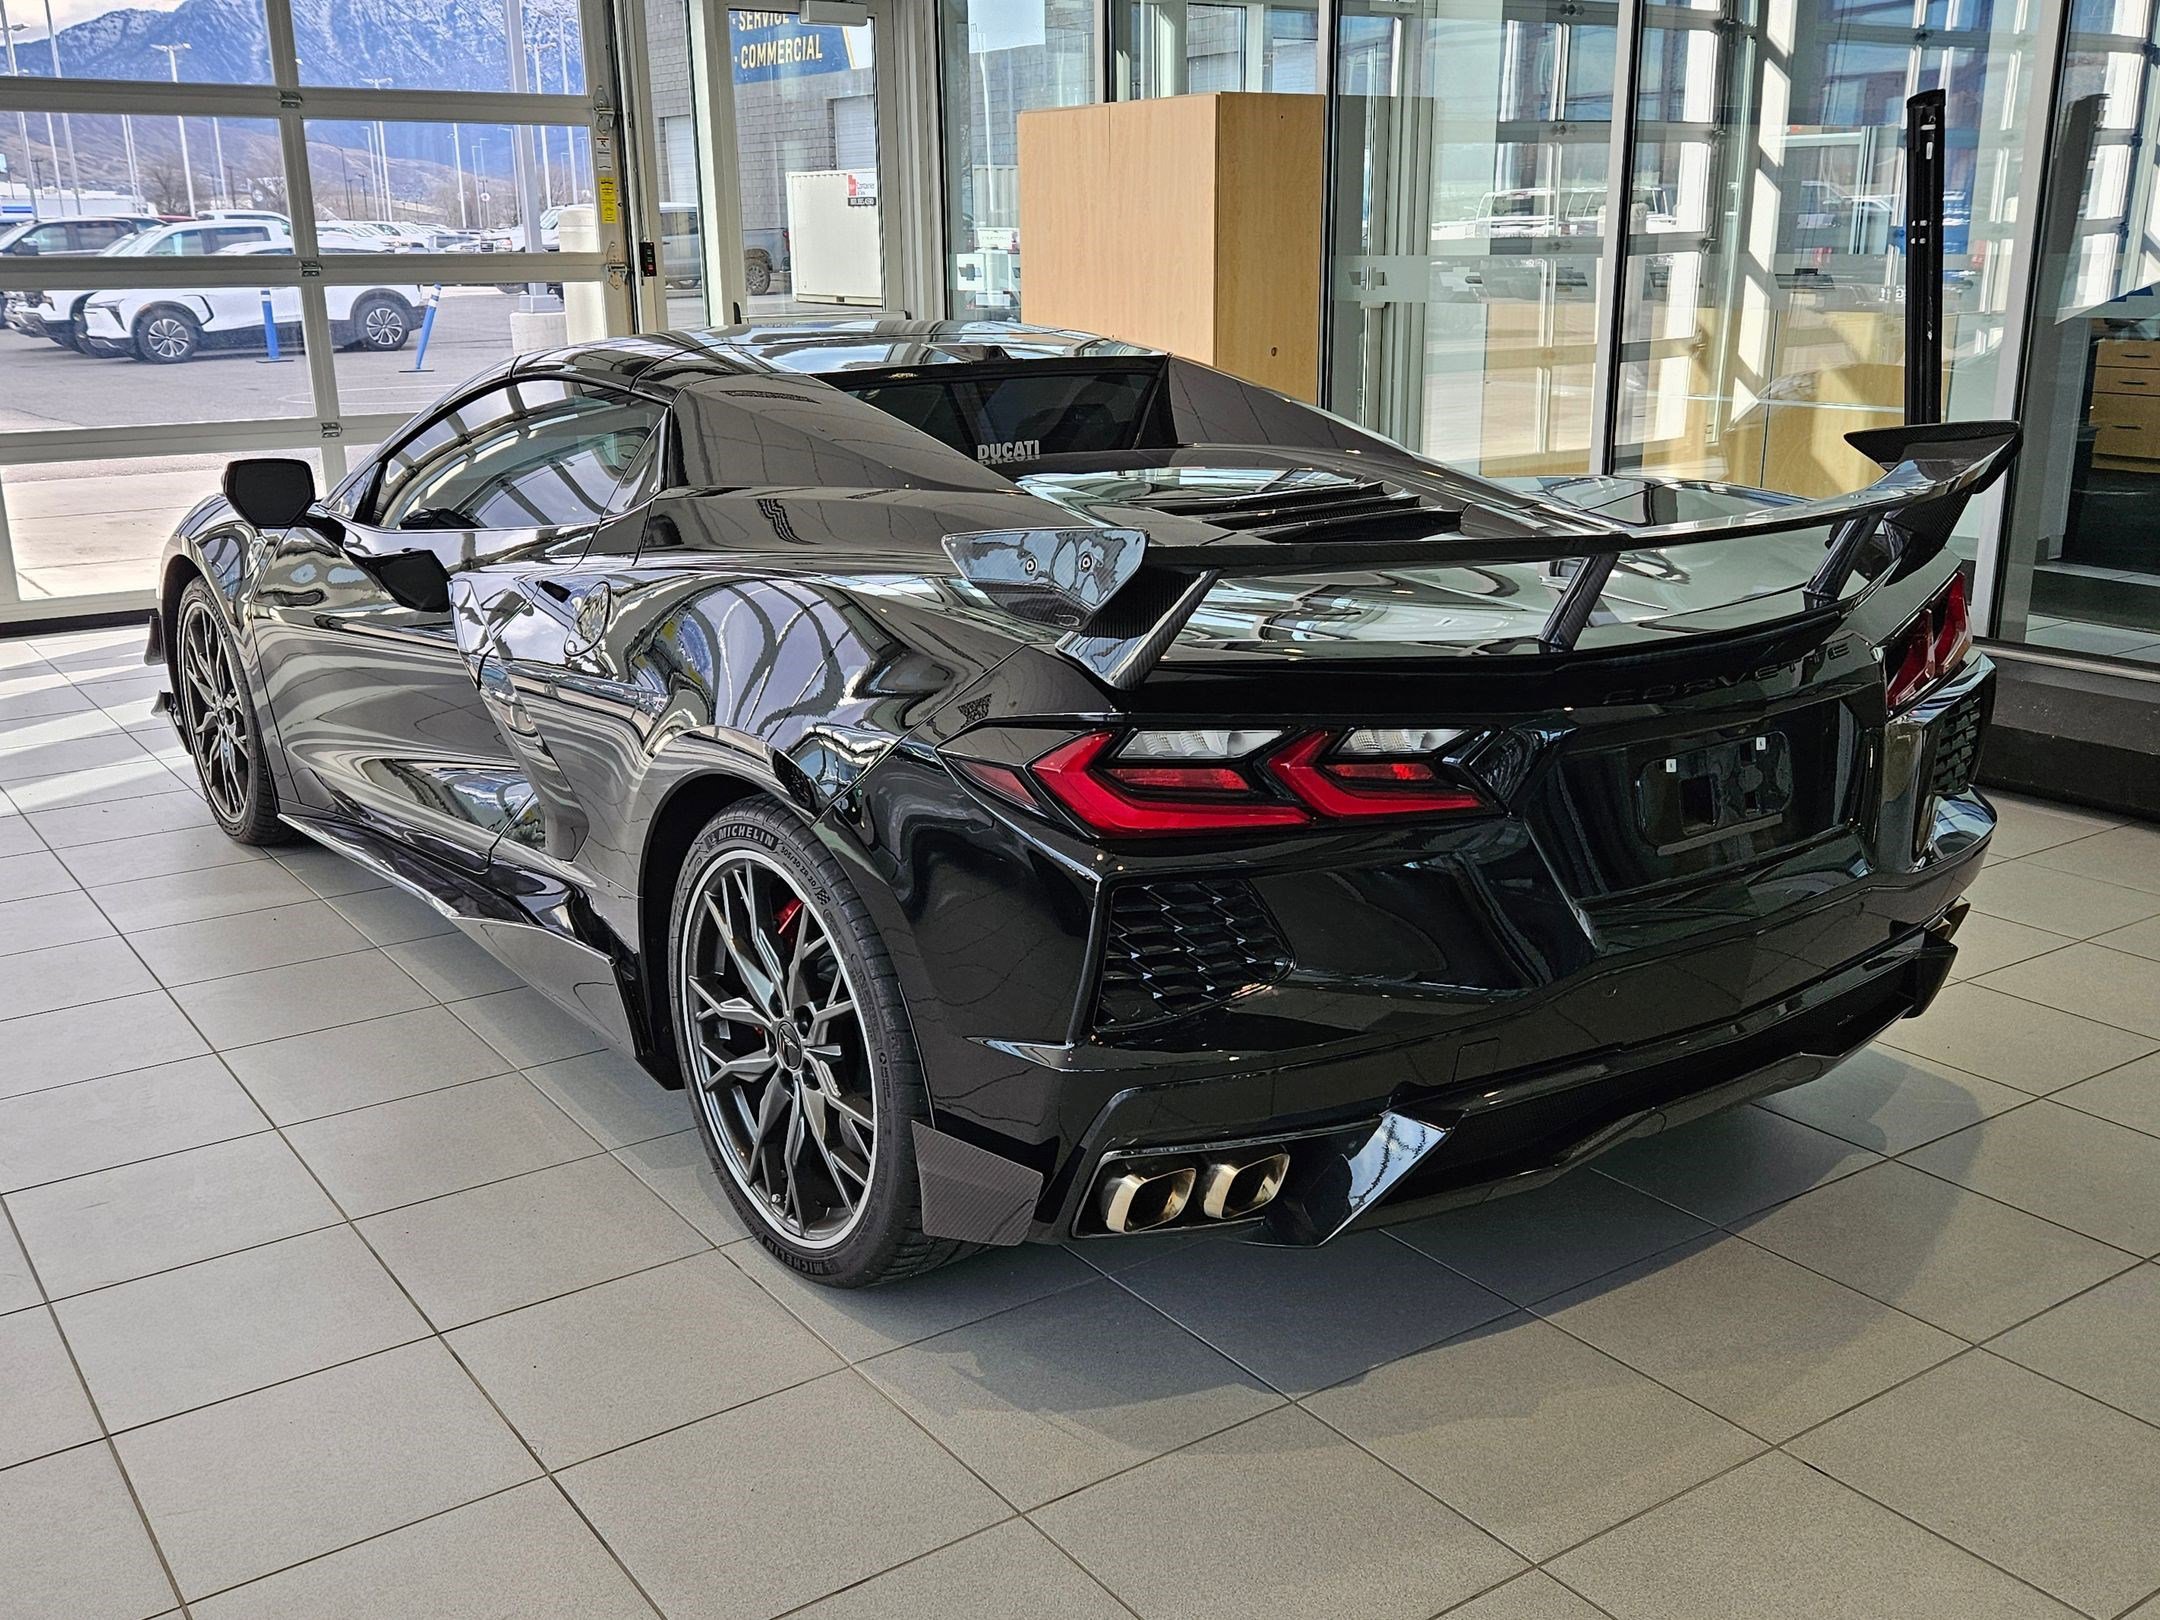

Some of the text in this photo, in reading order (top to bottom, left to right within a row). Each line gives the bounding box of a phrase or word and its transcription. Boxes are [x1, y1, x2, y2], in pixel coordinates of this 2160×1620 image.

[741, 34, 822, 70] COMMERCIAL
[977, 440, 1040, 460] DUCATI
[718, 824, 775, 848] MICHELIN
[781, 846, 801, 868] 305/30
[766, 1240, 824, 1275] MICHELIN
